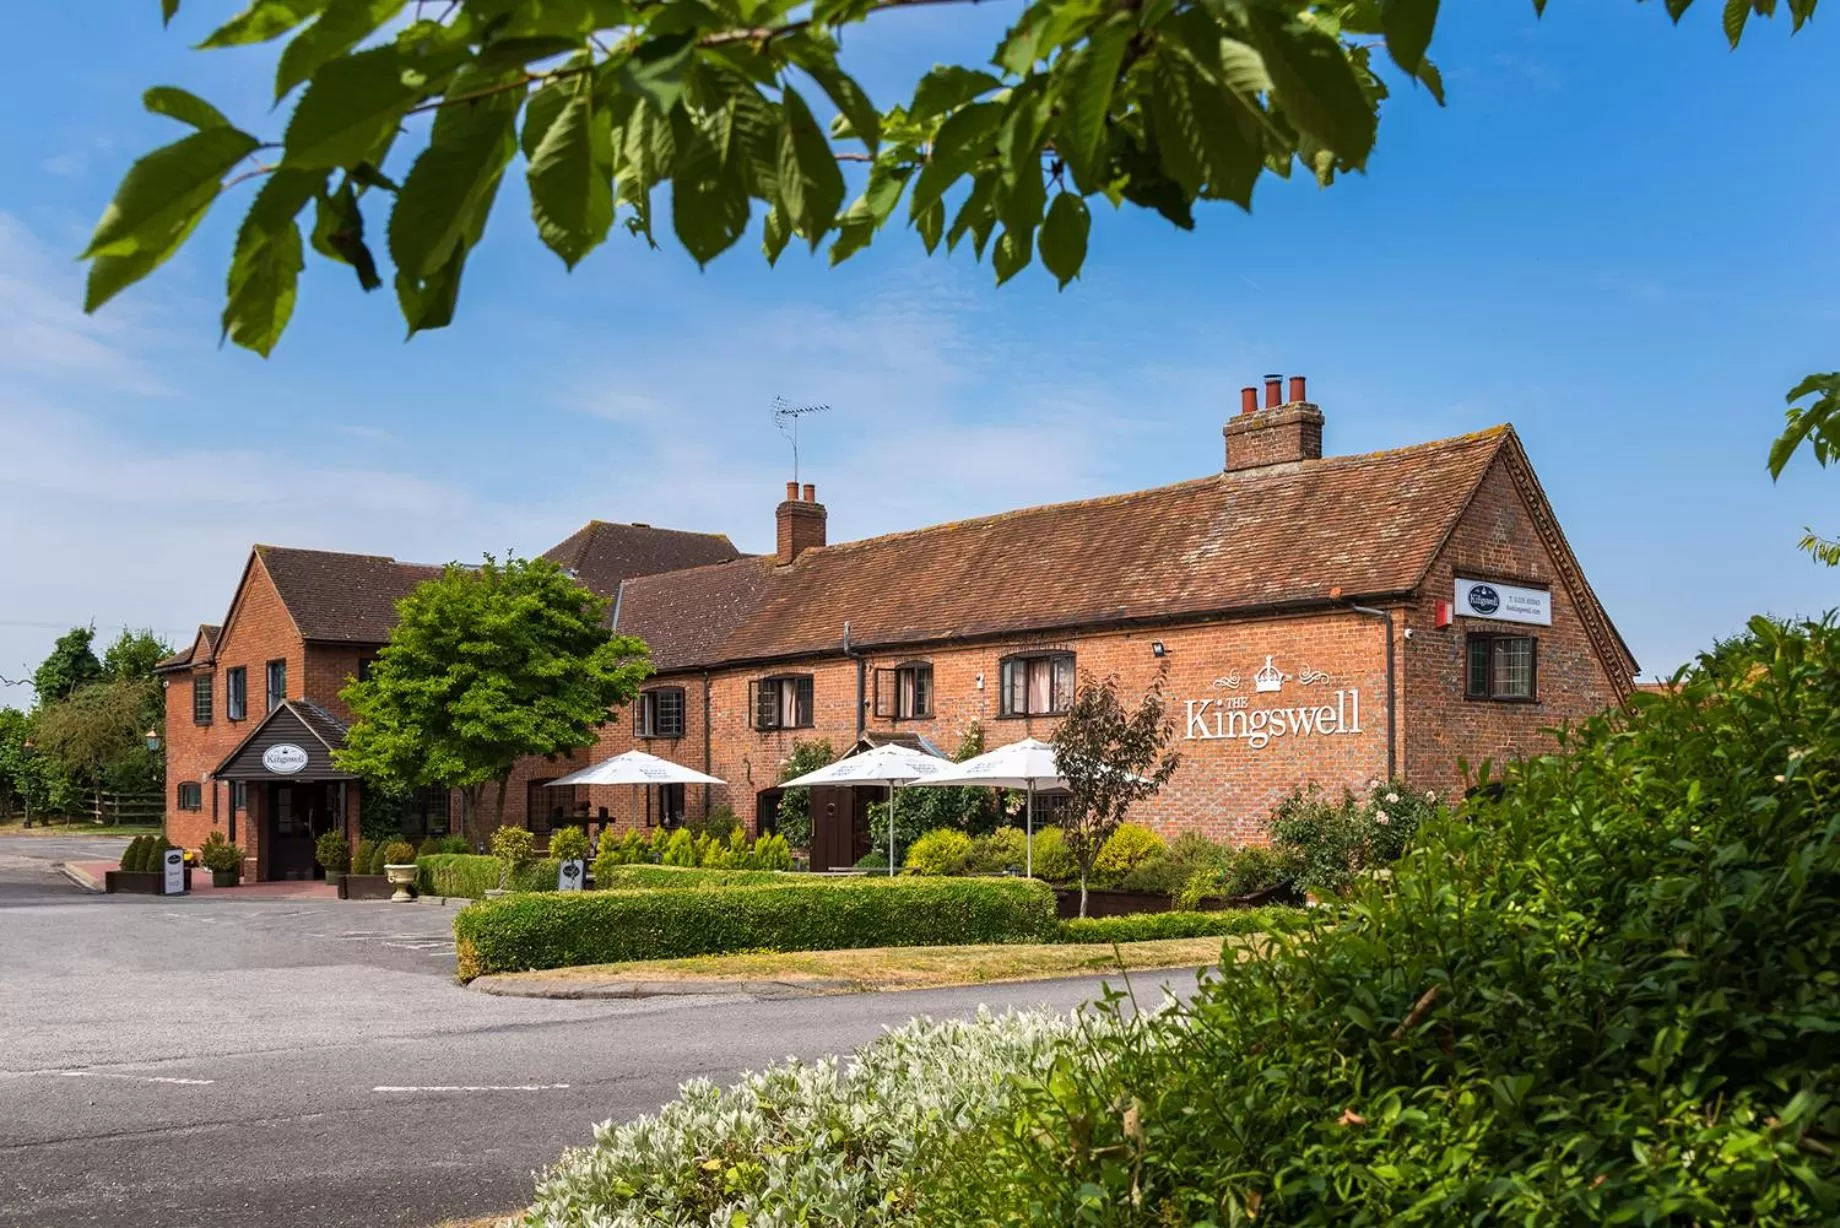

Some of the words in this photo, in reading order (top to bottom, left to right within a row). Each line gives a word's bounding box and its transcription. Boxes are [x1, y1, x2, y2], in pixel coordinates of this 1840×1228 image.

[1227, 696, 1248, 709] THE
[1184, 689, 1362, 749] Kingswell
[266, 754, 304, 764] Kingswell
